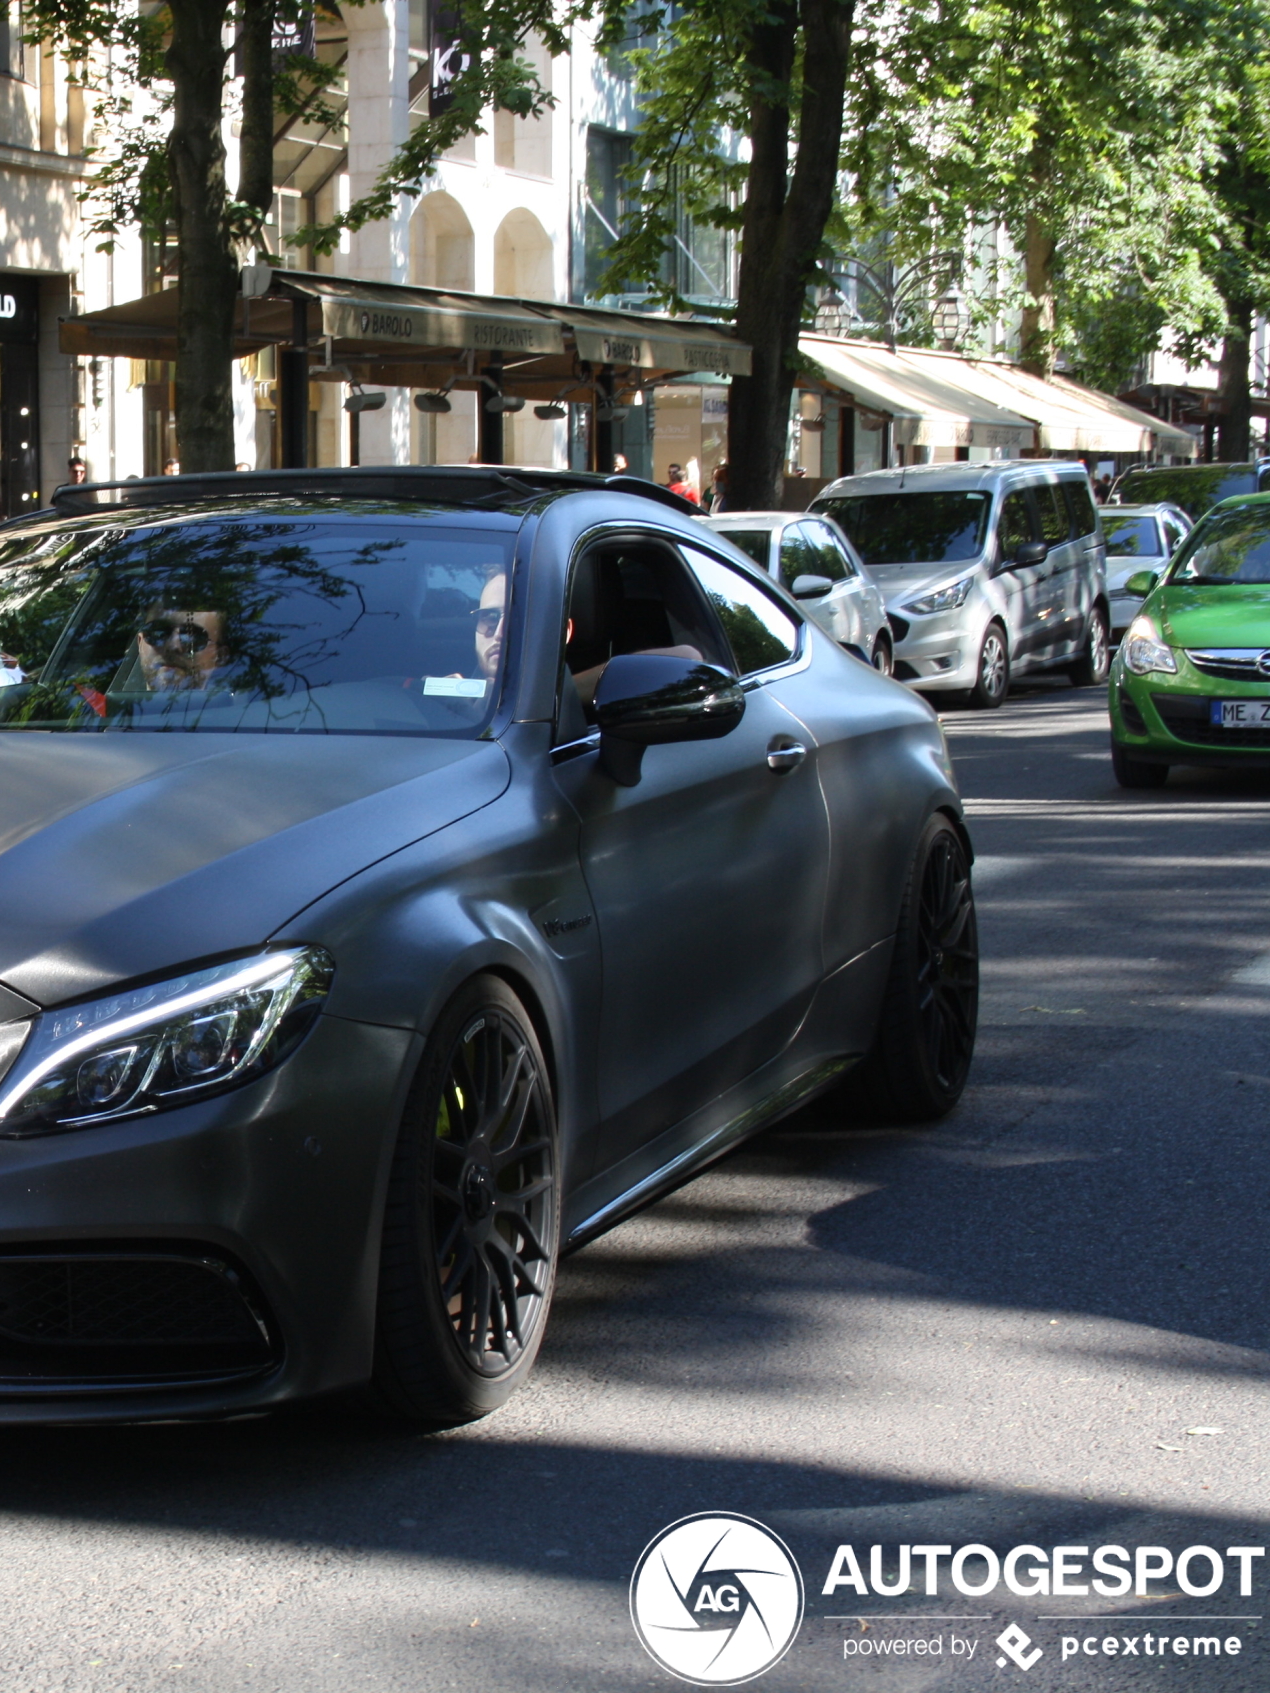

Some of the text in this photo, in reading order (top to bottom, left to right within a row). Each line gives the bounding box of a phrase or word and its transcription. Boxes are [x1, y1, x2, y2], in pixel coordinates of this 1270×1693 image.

[372, 314, 534, 347] BAROLO RISTORANTE
[1223, 704, 1247, 721] ME
